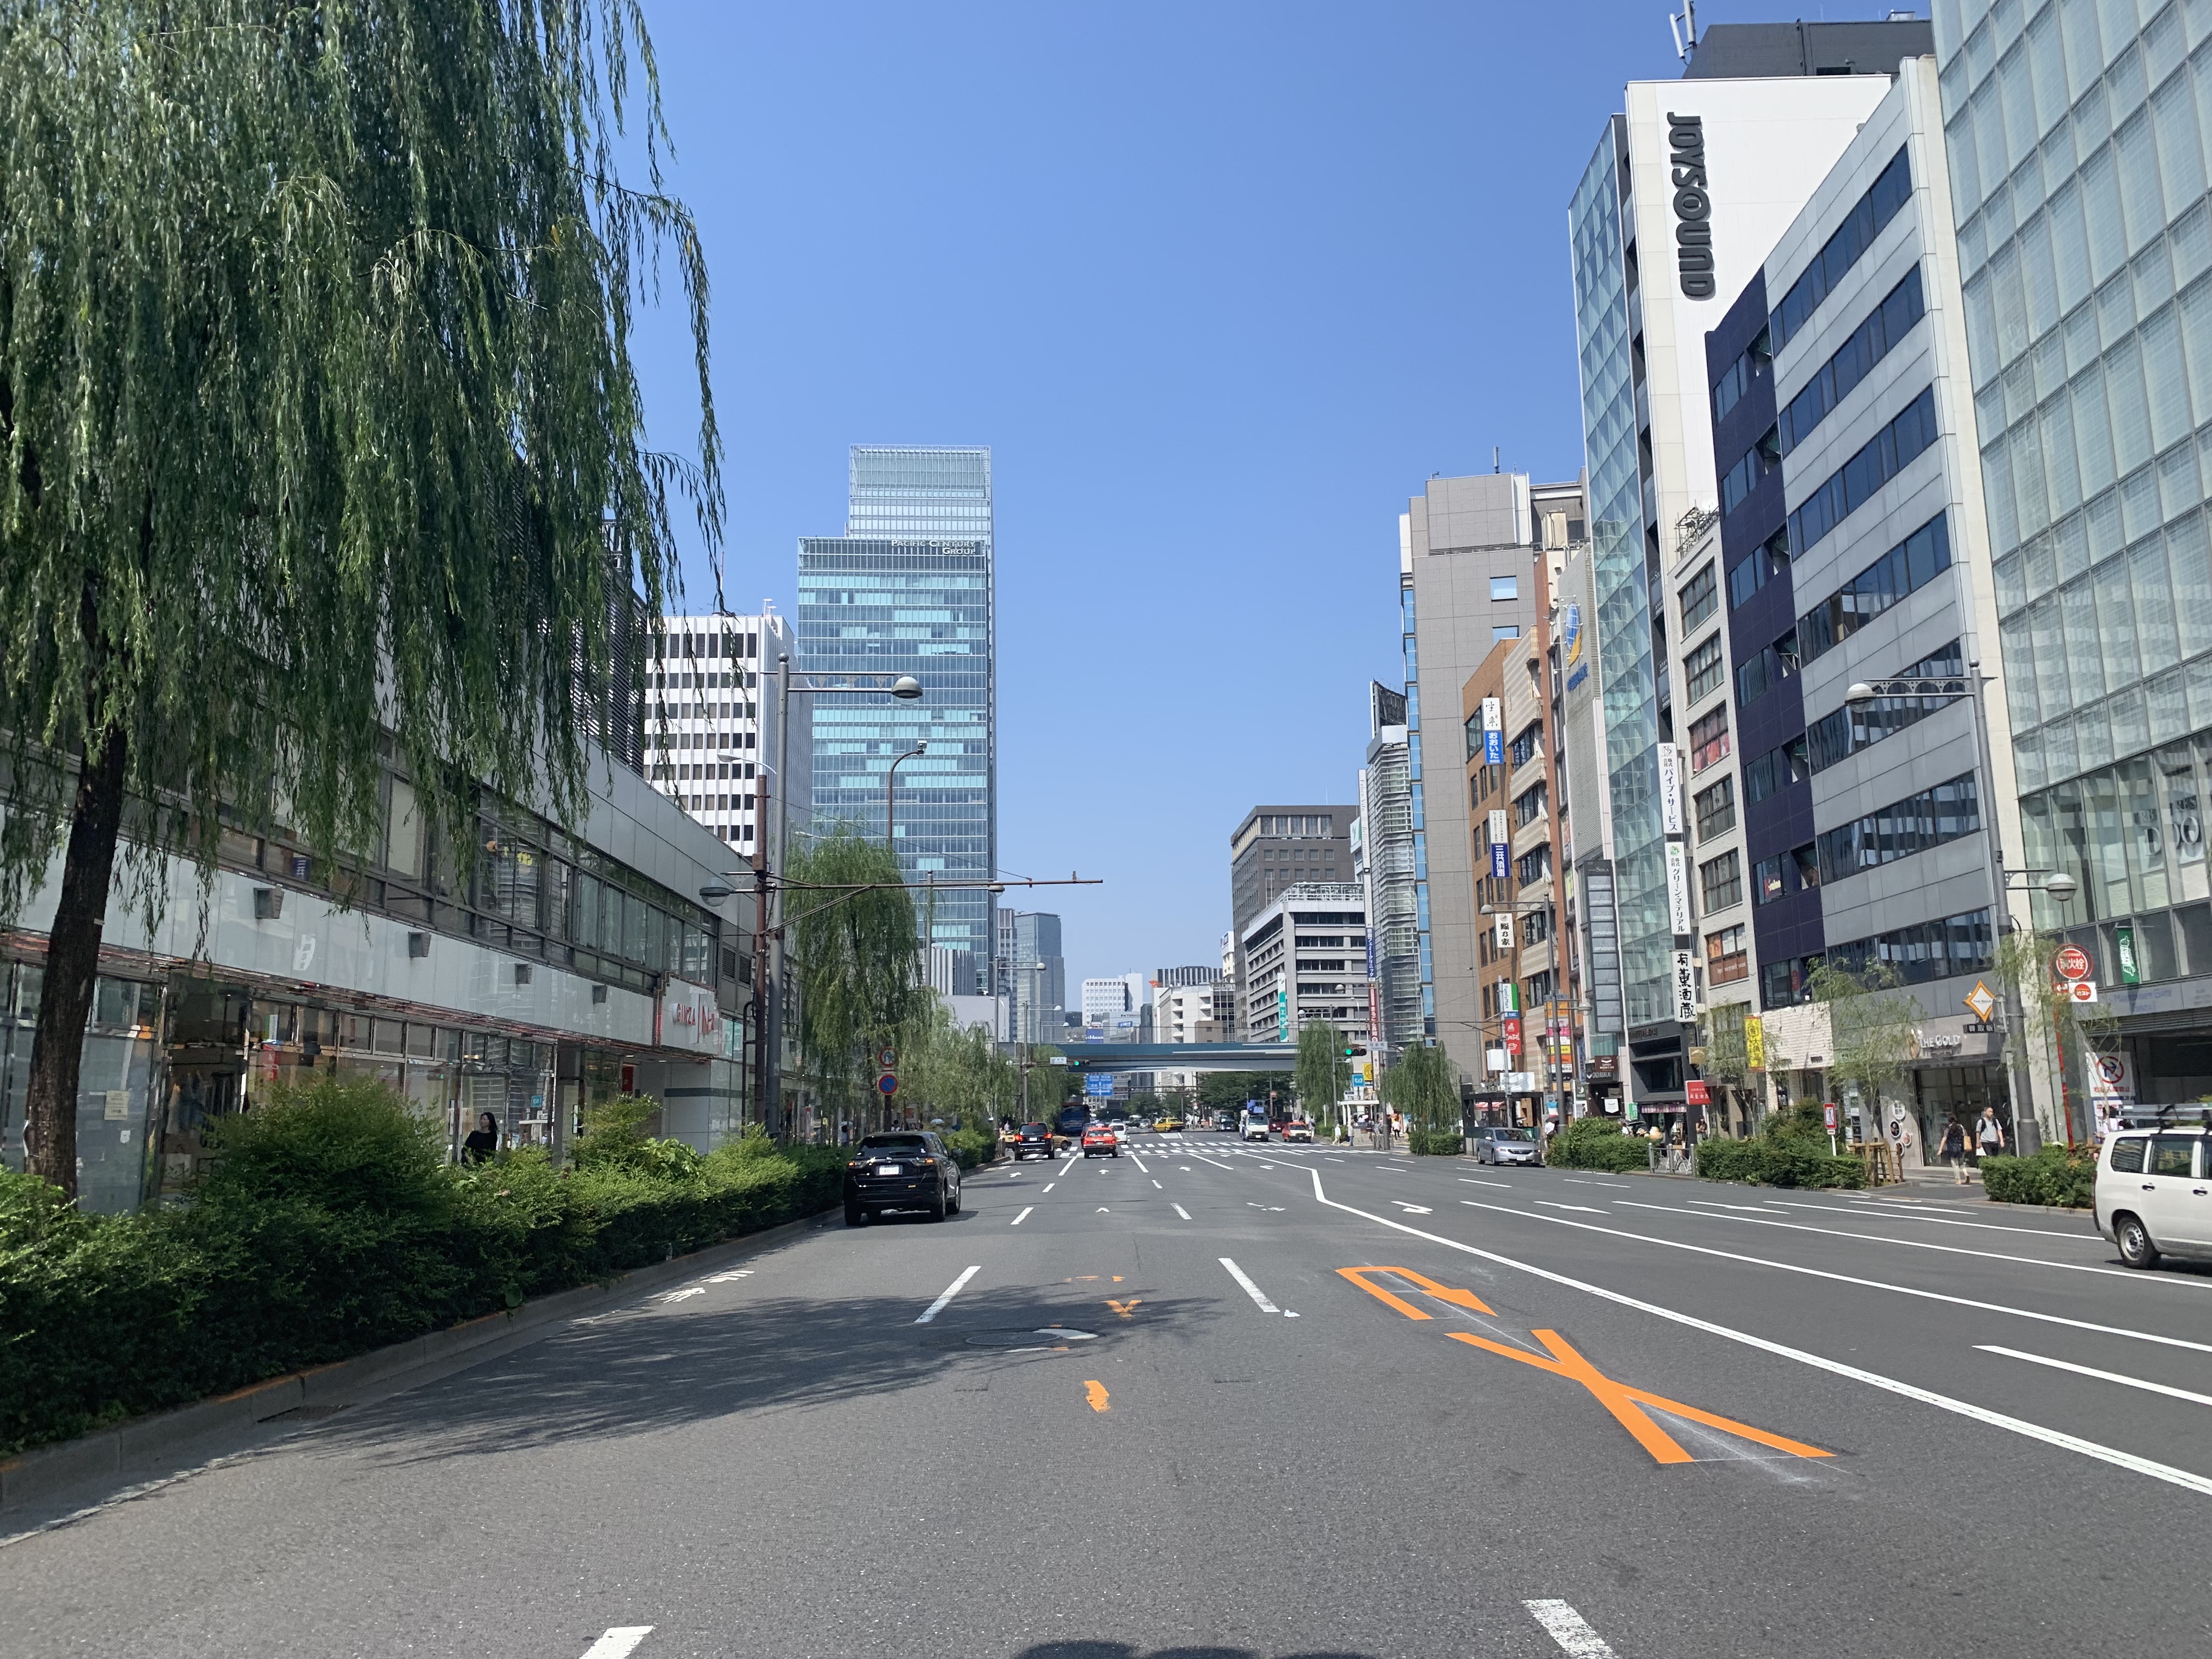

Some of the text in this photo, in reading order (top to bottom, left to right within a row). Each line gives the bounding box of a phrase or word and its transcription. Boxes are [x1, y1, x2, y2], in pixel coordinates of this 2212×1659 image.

[1667, 111, 1716, 300] JOYSOUND
[1488, 732, 1499, 759] おおいた
[1664, 769, 1678, 831] パイプ・サービス
[1672, 868, 1685, 933] グリーン・マテリアル
[1677, 952, 1696, 1019] 有薫酒蔵
[2059, 958, 2085, 970] 消火栓
[1921, 1034, 1961, 1048] THE GOLD
